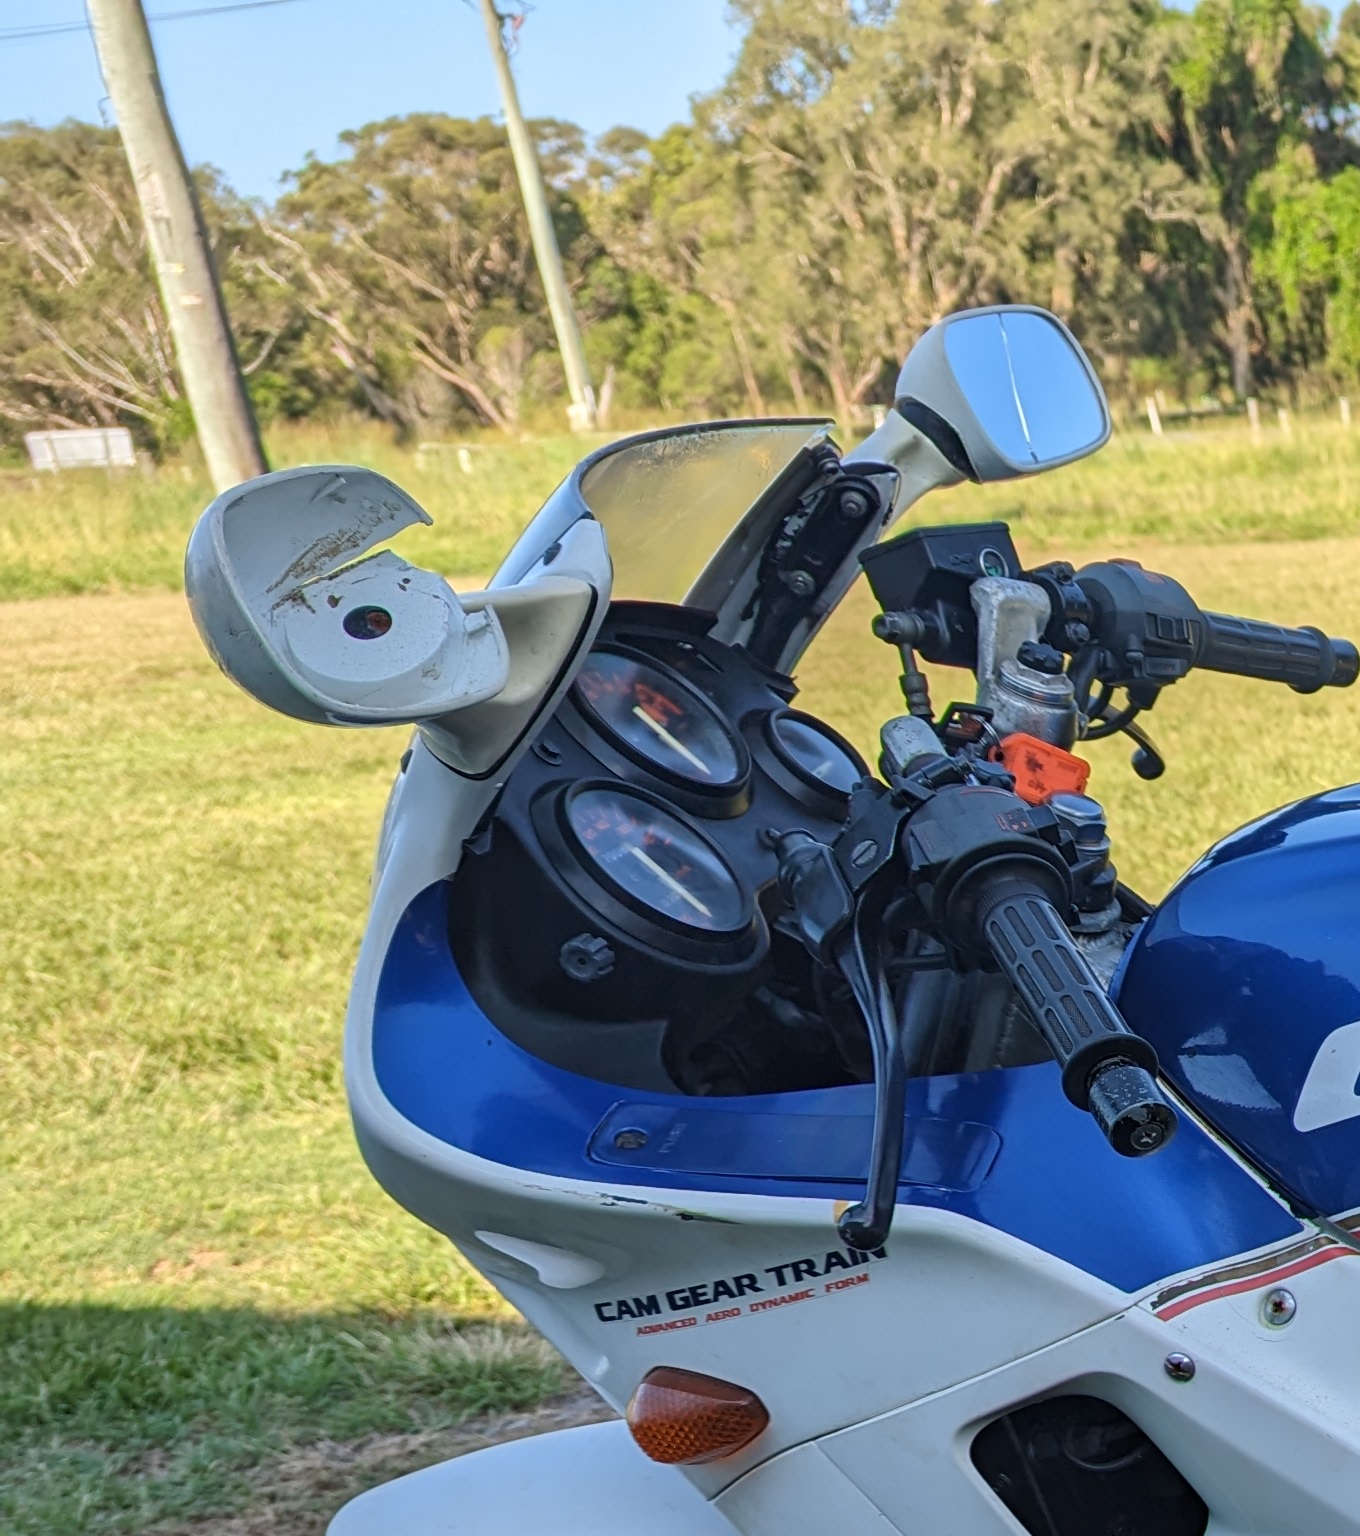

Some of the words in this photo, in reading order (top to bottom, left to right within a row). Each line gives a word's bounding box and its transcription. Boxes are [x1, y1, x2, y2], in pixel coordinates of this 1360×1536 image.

[594, 1294, 662, 1322] CAM
[665, 1273, 766, 1311] GEAR
[706, 1307, 740, 1323] AERO
[749, 1288, 816, 1313] DYNAMIC
[824, 1272, 869, 1293] FORM
